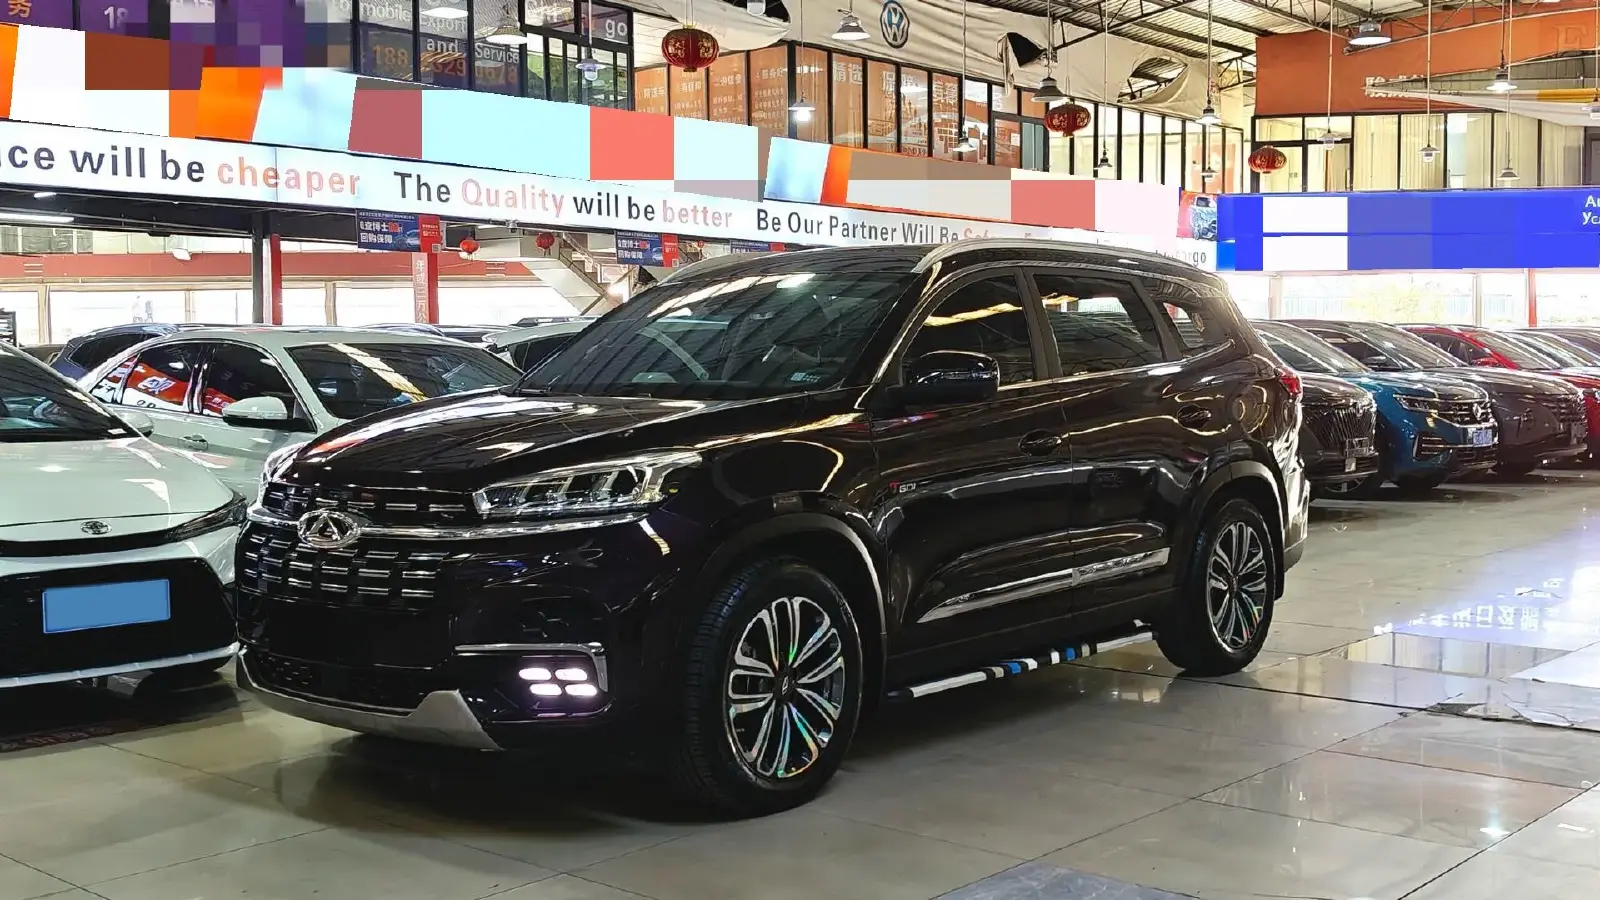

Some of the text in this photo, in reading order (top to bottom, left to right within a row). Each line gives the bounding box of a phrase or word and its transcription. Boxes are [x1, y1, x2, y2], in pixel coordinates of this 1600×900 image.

[427, 38, 520, 64] and Service
[71, 144, 146, 178] will
[161, 150, 205, 183] be
[217, 157, 361, 198] cheaper
[394, 171, 733, 229] The Quality will be better
[757, 209, 783, 233] Be
[787, 212, 823, 237] Our
[829, 215, 897, 242] Partner
[902, 222, 934, 244] Will
